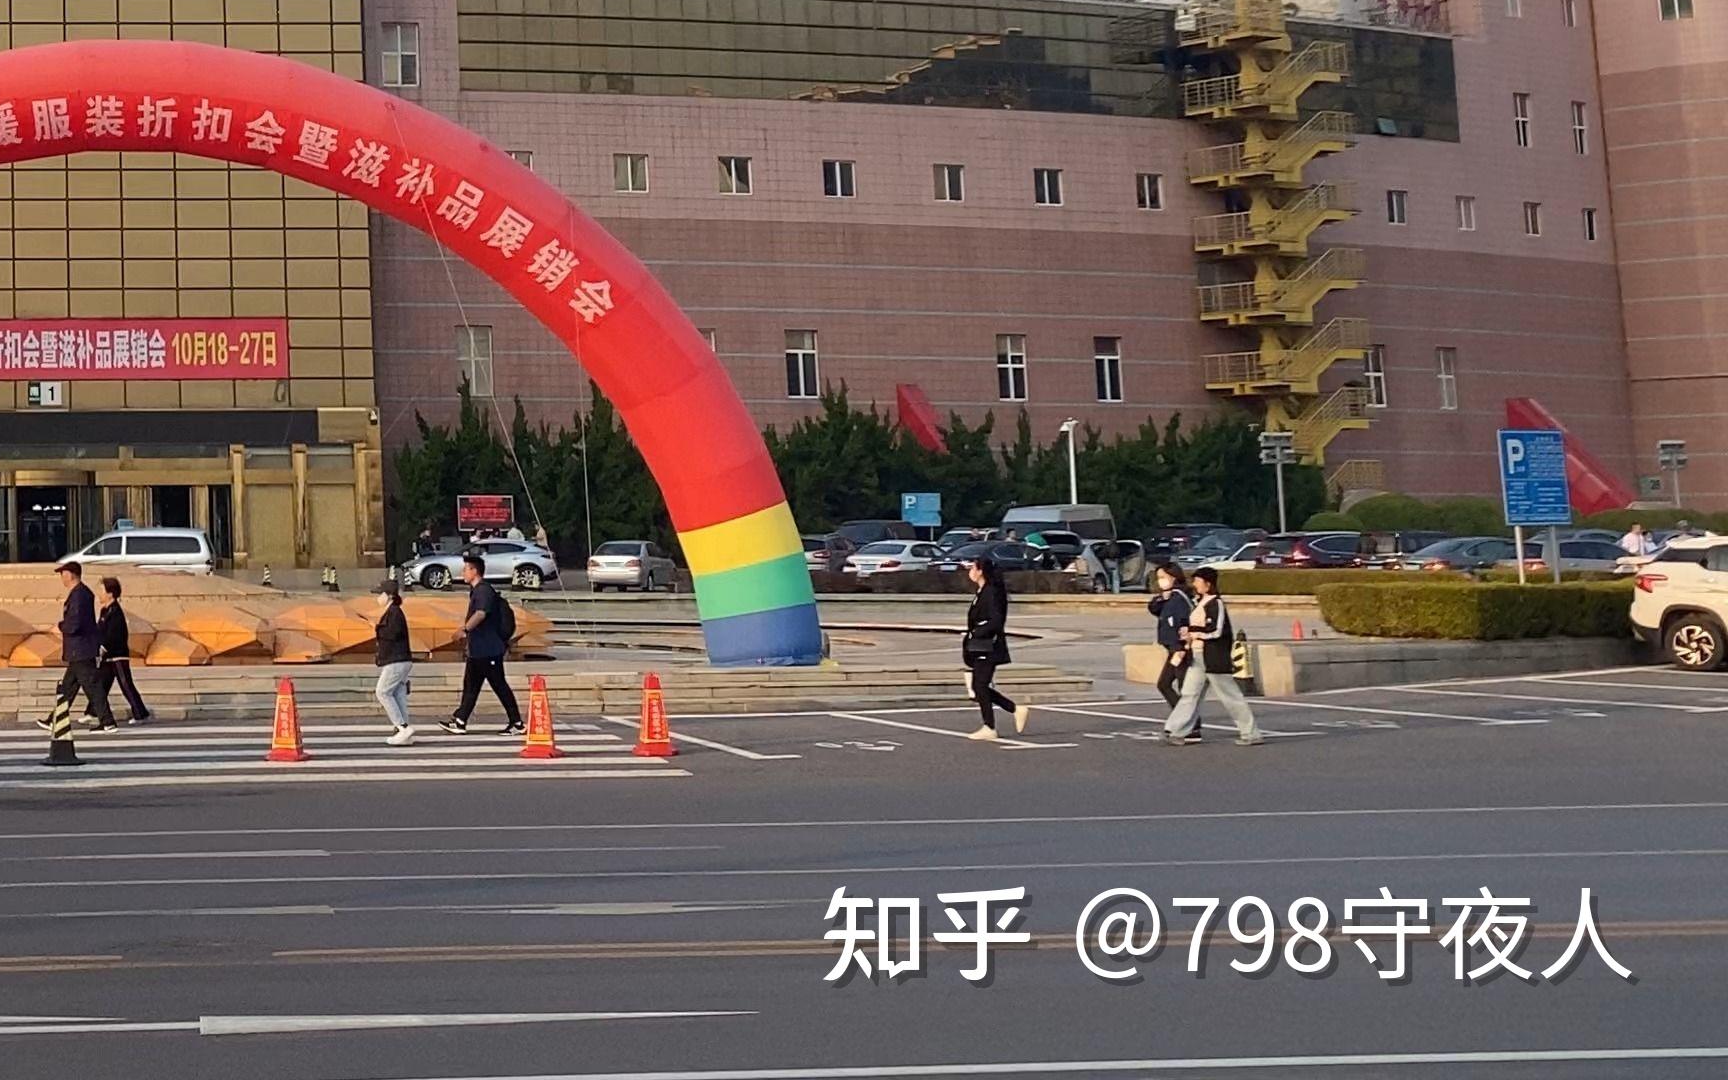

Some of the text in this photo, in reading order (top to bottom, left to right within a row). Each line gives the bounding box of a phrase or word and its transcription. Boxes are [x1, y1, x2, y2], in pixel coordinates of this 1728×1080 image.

[171, 331, 278, 367] 10月18-27日
[48, 386, 54, 401] 1
[1506, 439, 1525, 474] P
[905, 495, 917, 509] P
